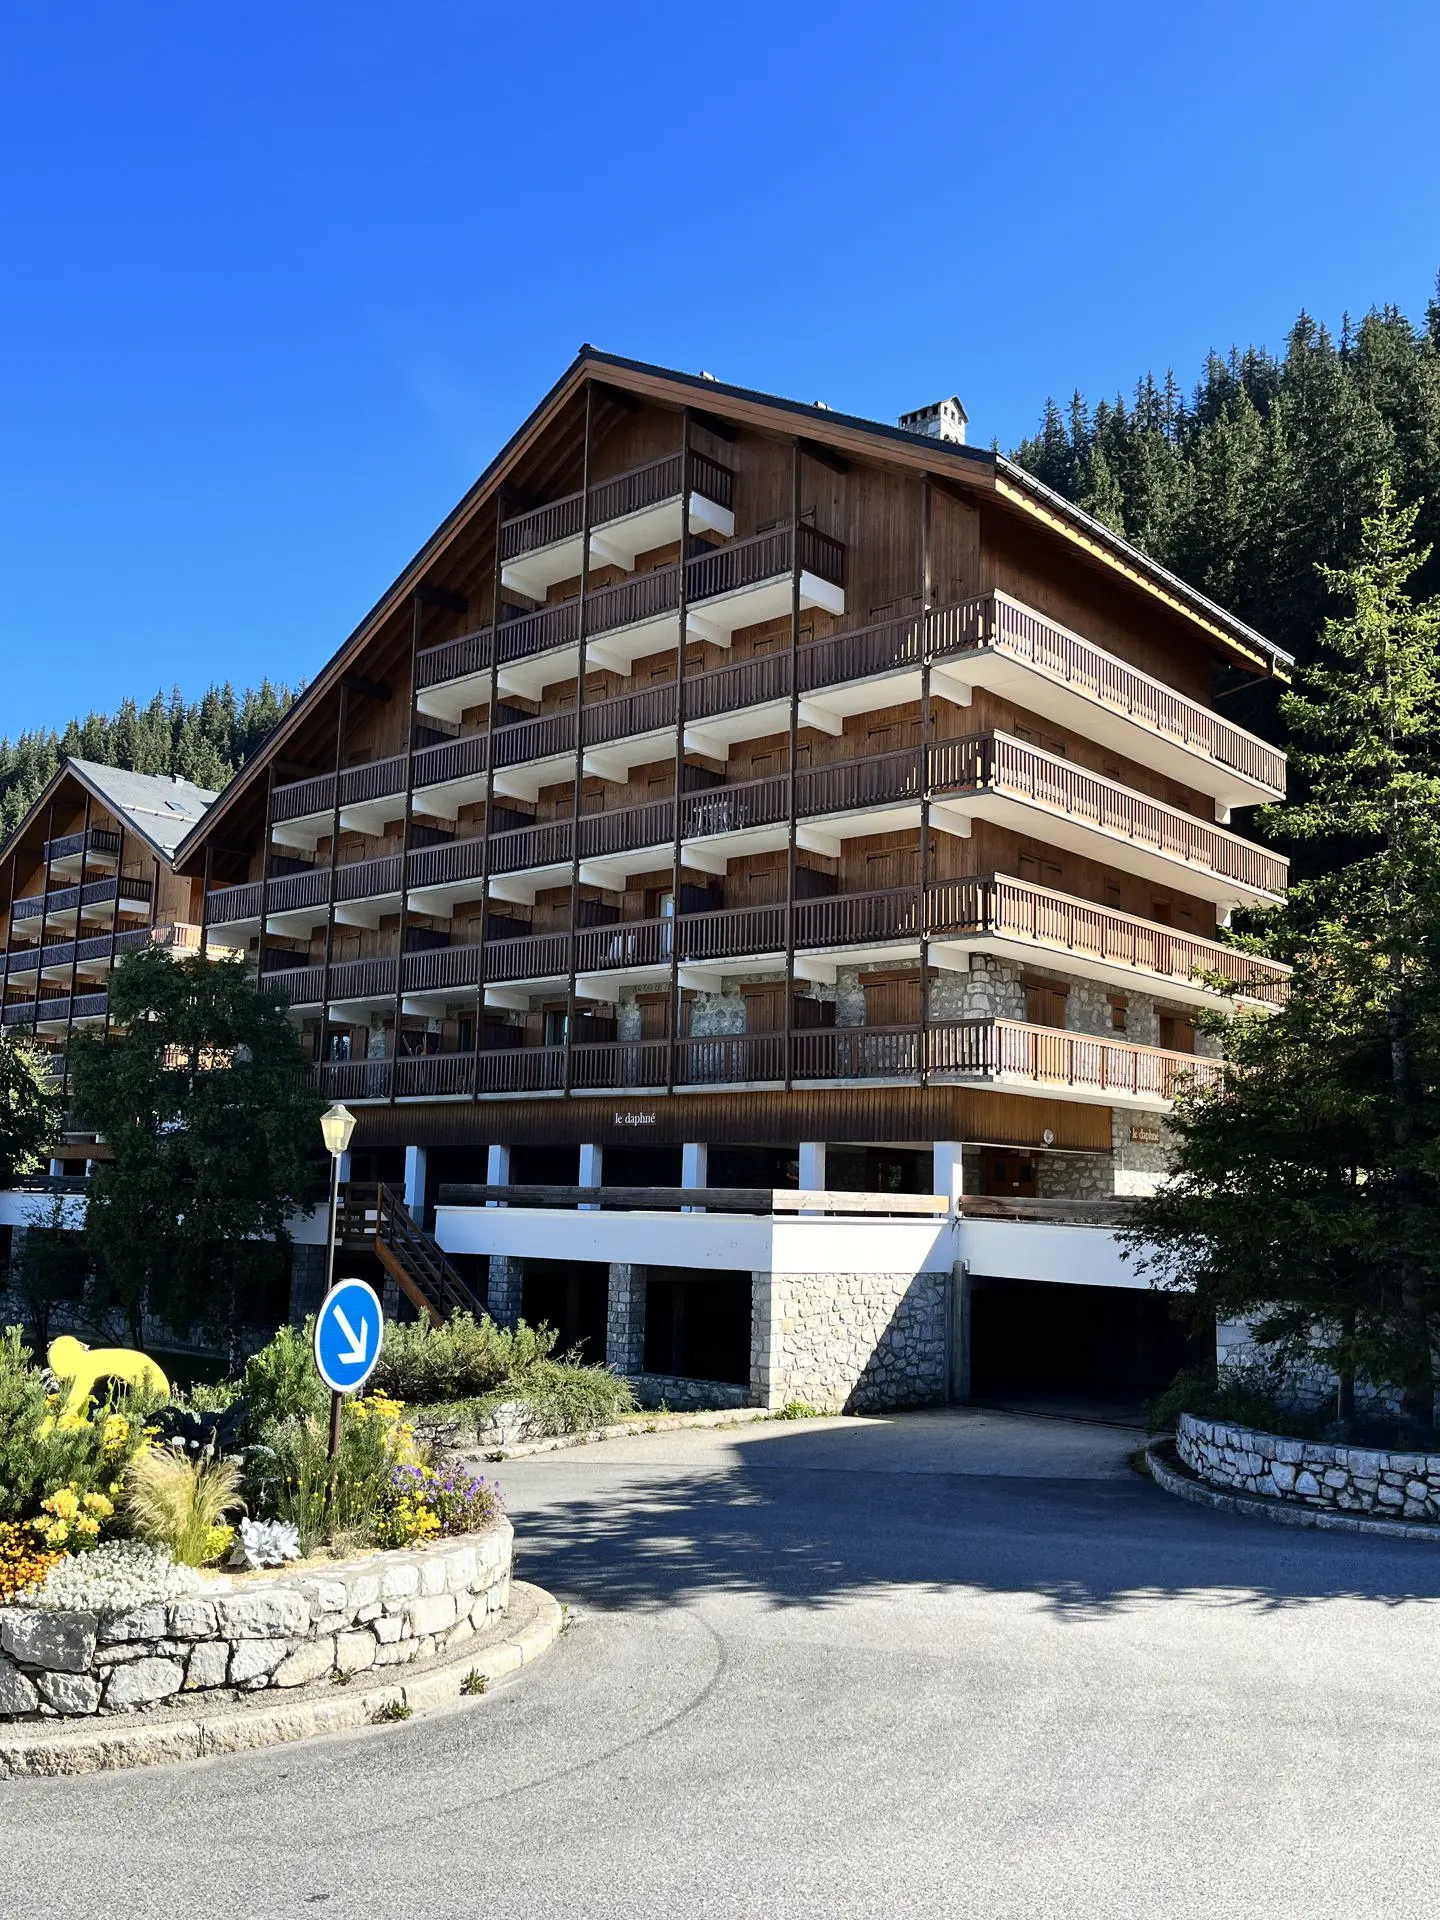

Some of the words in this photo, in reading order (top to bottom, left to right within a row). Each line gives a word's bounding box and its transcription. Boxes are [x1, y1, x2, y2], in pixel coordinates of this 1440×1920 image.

[615, 1112, 622, 1123] le
[624, 1112, 656, 1126] daphné
[1132, 1127, 1138, 1139] le
